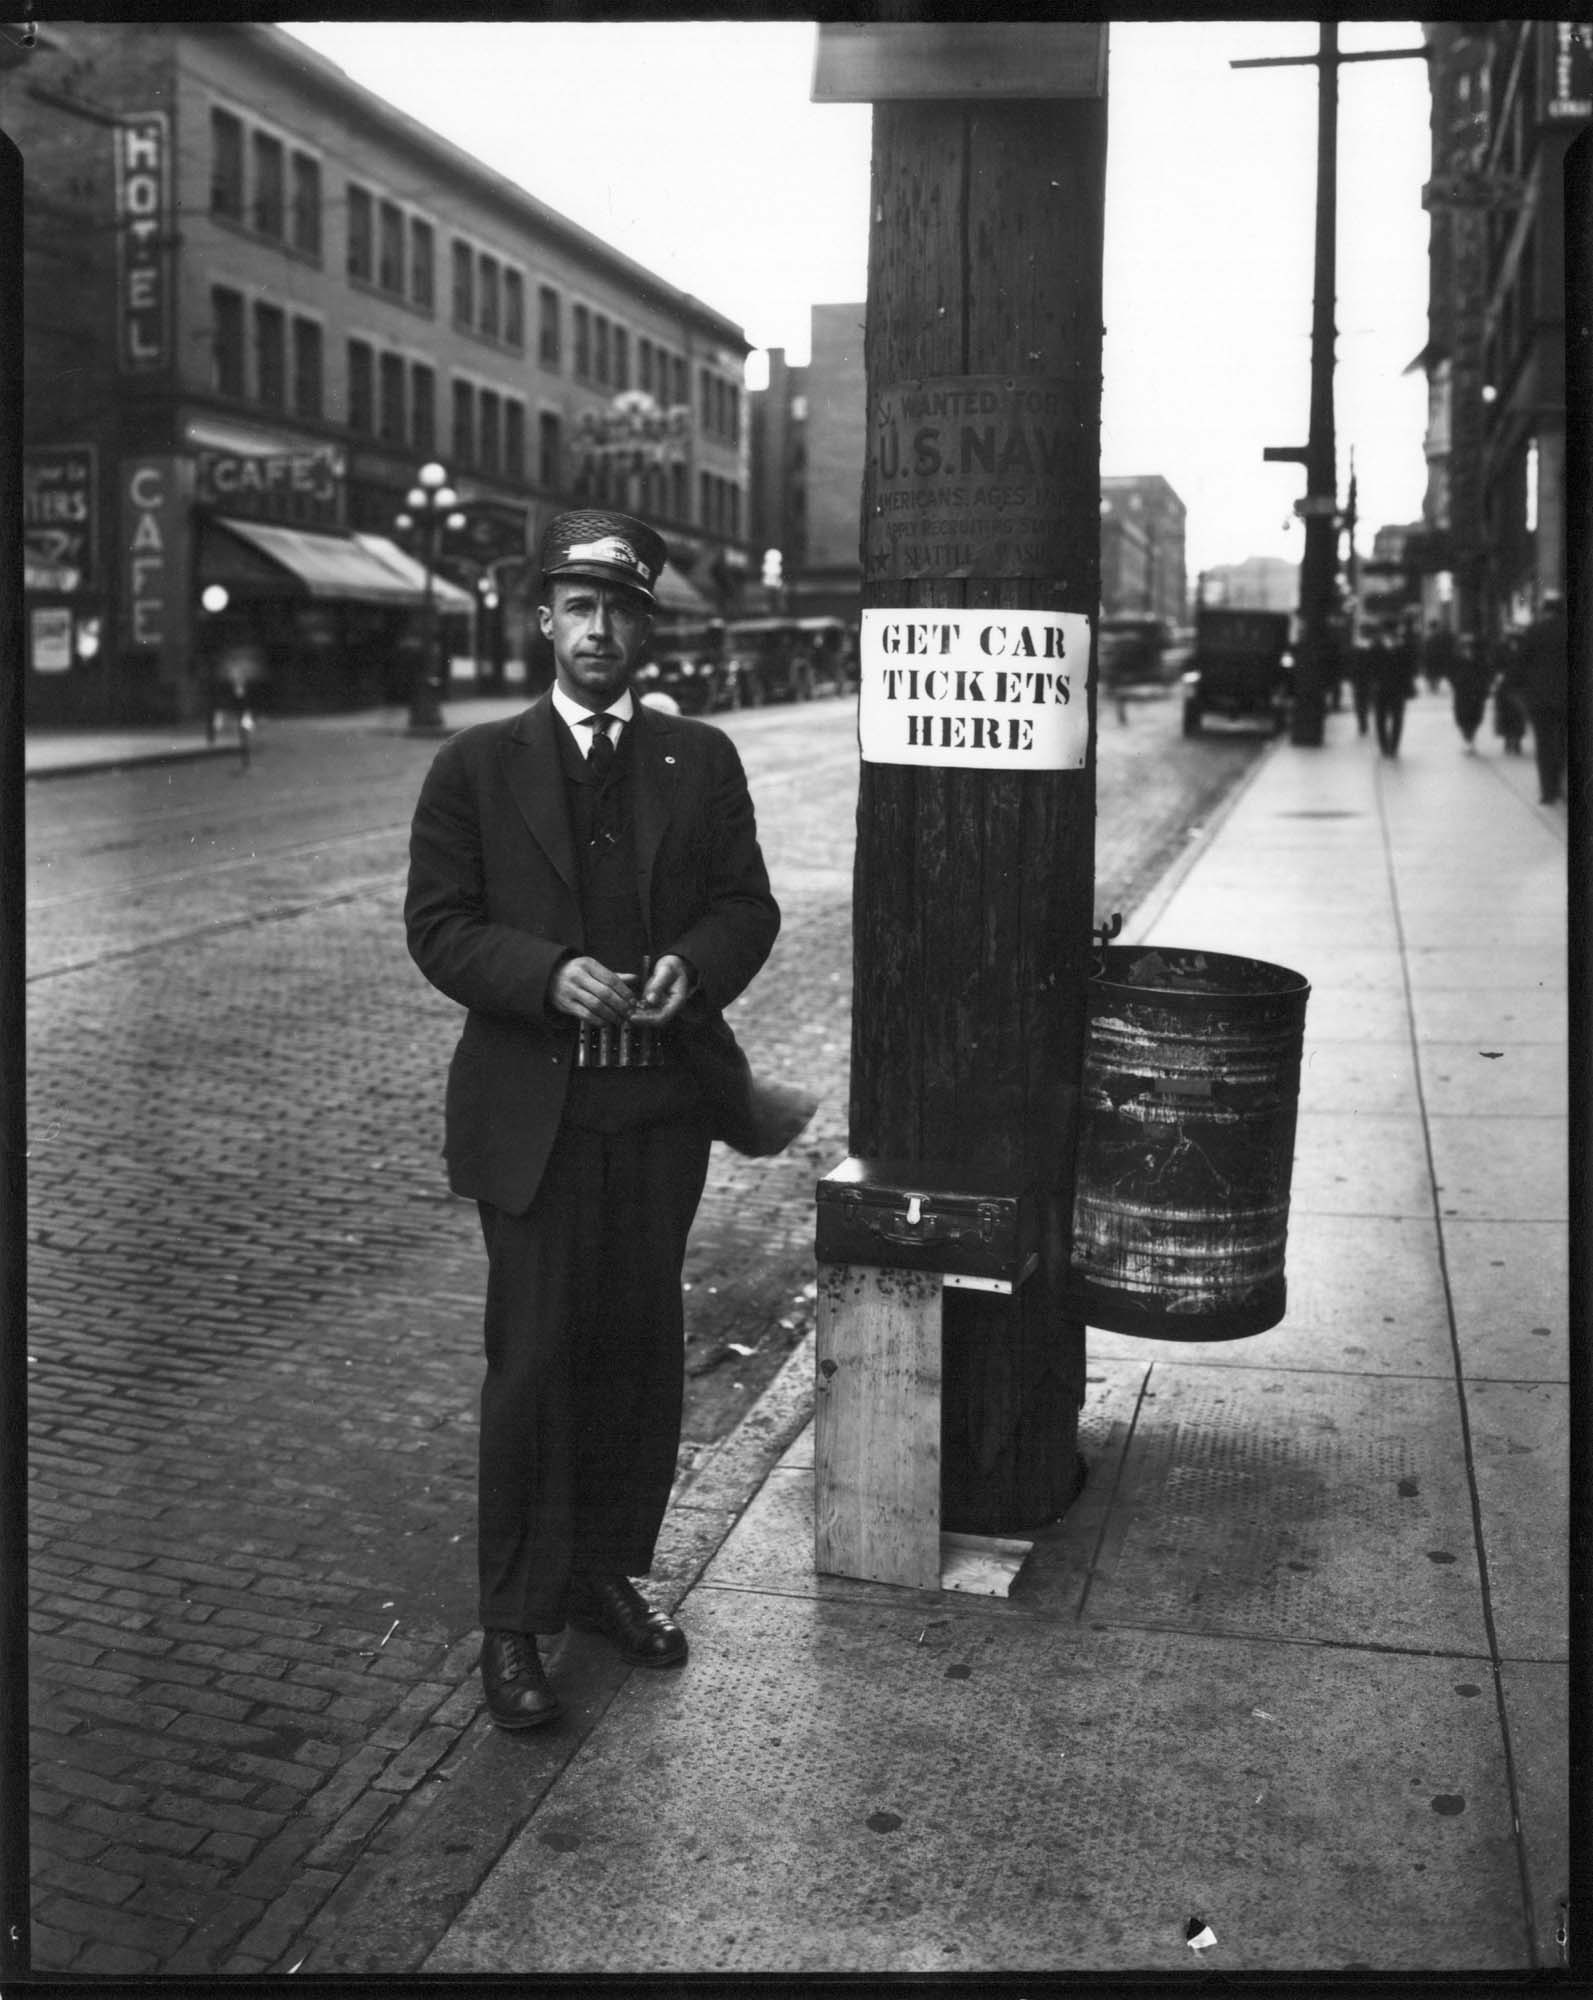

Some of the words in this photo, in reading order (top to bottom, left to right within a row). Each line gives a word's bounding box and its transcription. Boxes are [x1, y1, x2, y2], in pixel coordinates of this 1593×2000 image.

[127, 128, 158, 358] HOTEL
[902, 391, 998, 419] WANTED
[213, 456, 315, 492] CAFE
[130, 468, 164, 643] CAFE
[882, 624, 960, 655] GET
[979, 625, 1066, 659] CAR
[883, 669, 1071, 705] TICKETS
[907, 715, 1034, 751] HERE
